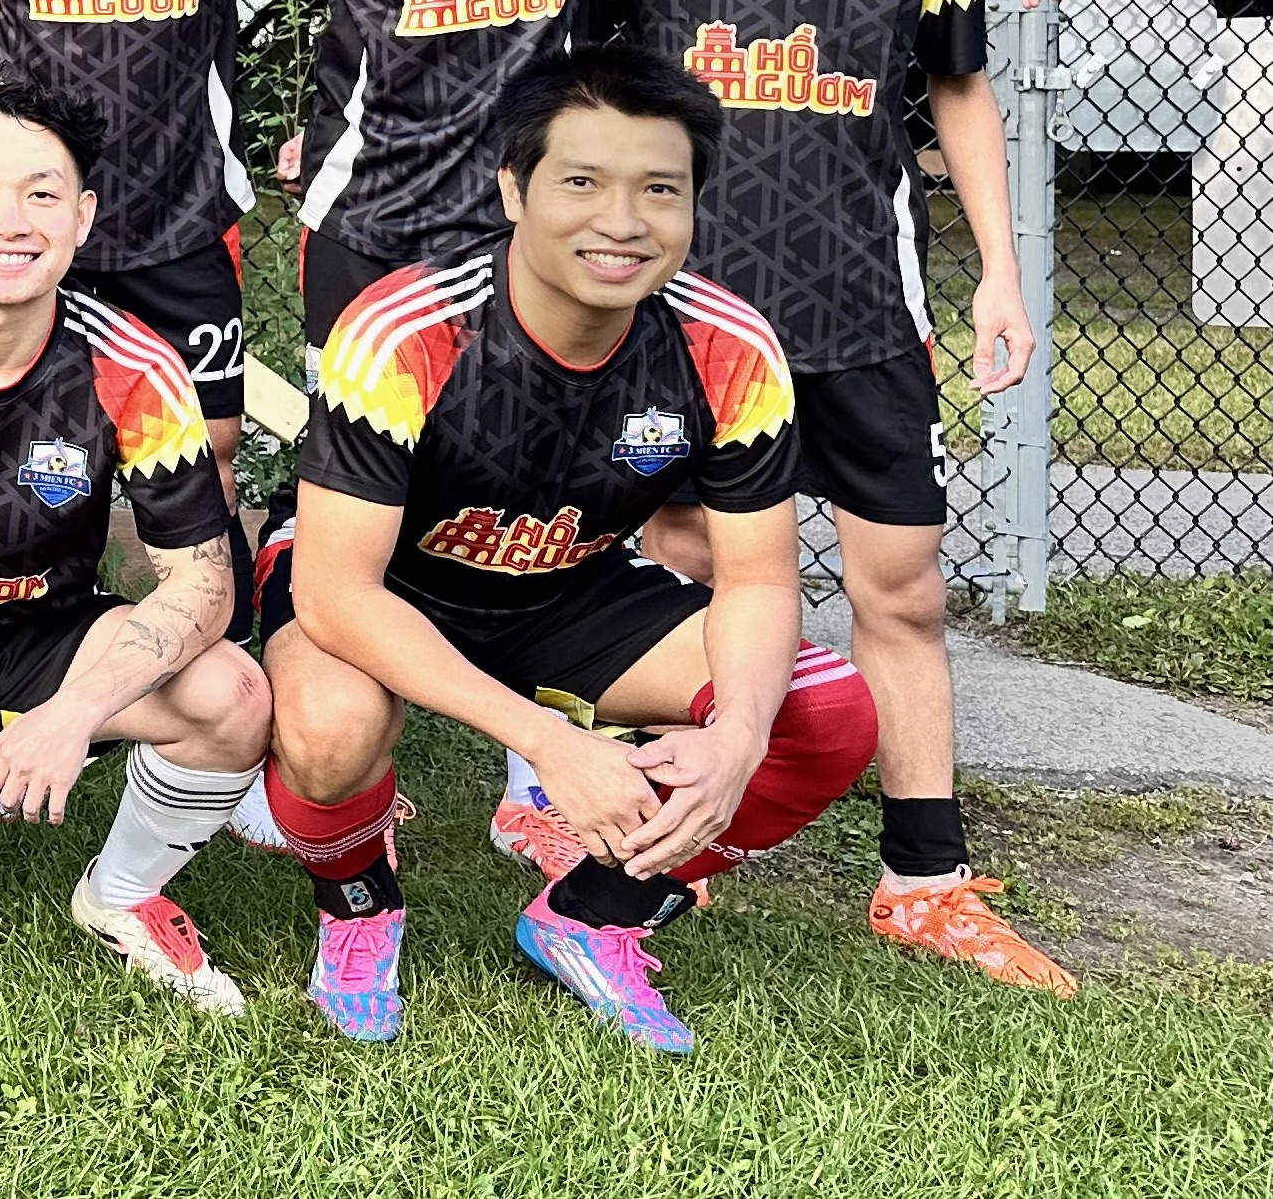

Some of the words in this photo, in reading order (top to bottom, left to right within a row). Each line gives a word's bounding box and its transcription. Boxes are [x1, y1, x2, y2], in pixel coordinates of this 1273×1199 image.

[756, 27, 817, 72] HỒ
[755, 66, 876, 112] GƯƠM
[188, 316, 244, 382] 22
[510, 509, 579, 549] HỒ
